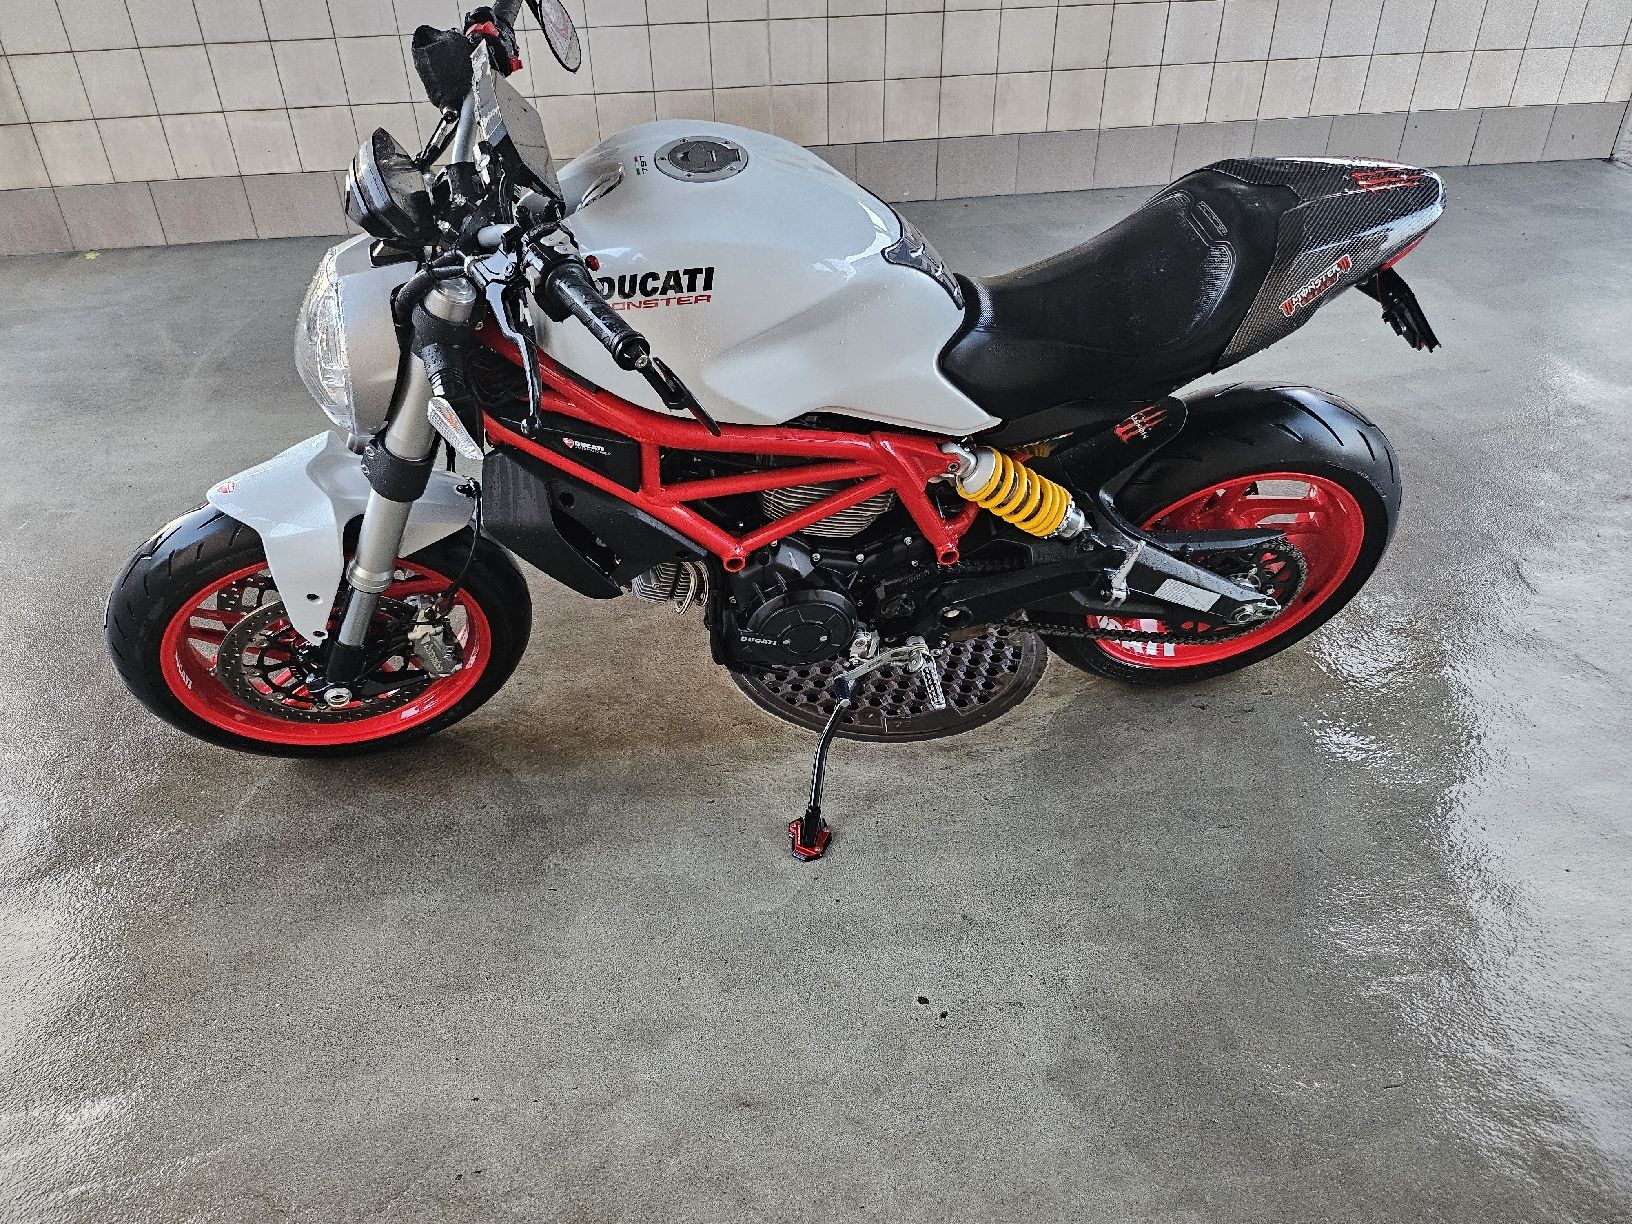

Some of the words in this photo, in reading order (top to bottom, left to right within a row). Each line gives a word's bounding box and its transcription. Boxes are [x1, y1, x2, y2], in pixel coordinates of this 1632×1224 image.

[597, 266, 715, 300] DUCATI
[609, 294, 712, 311] ONSTER
[740, 635, 777, 646] DUCATI
